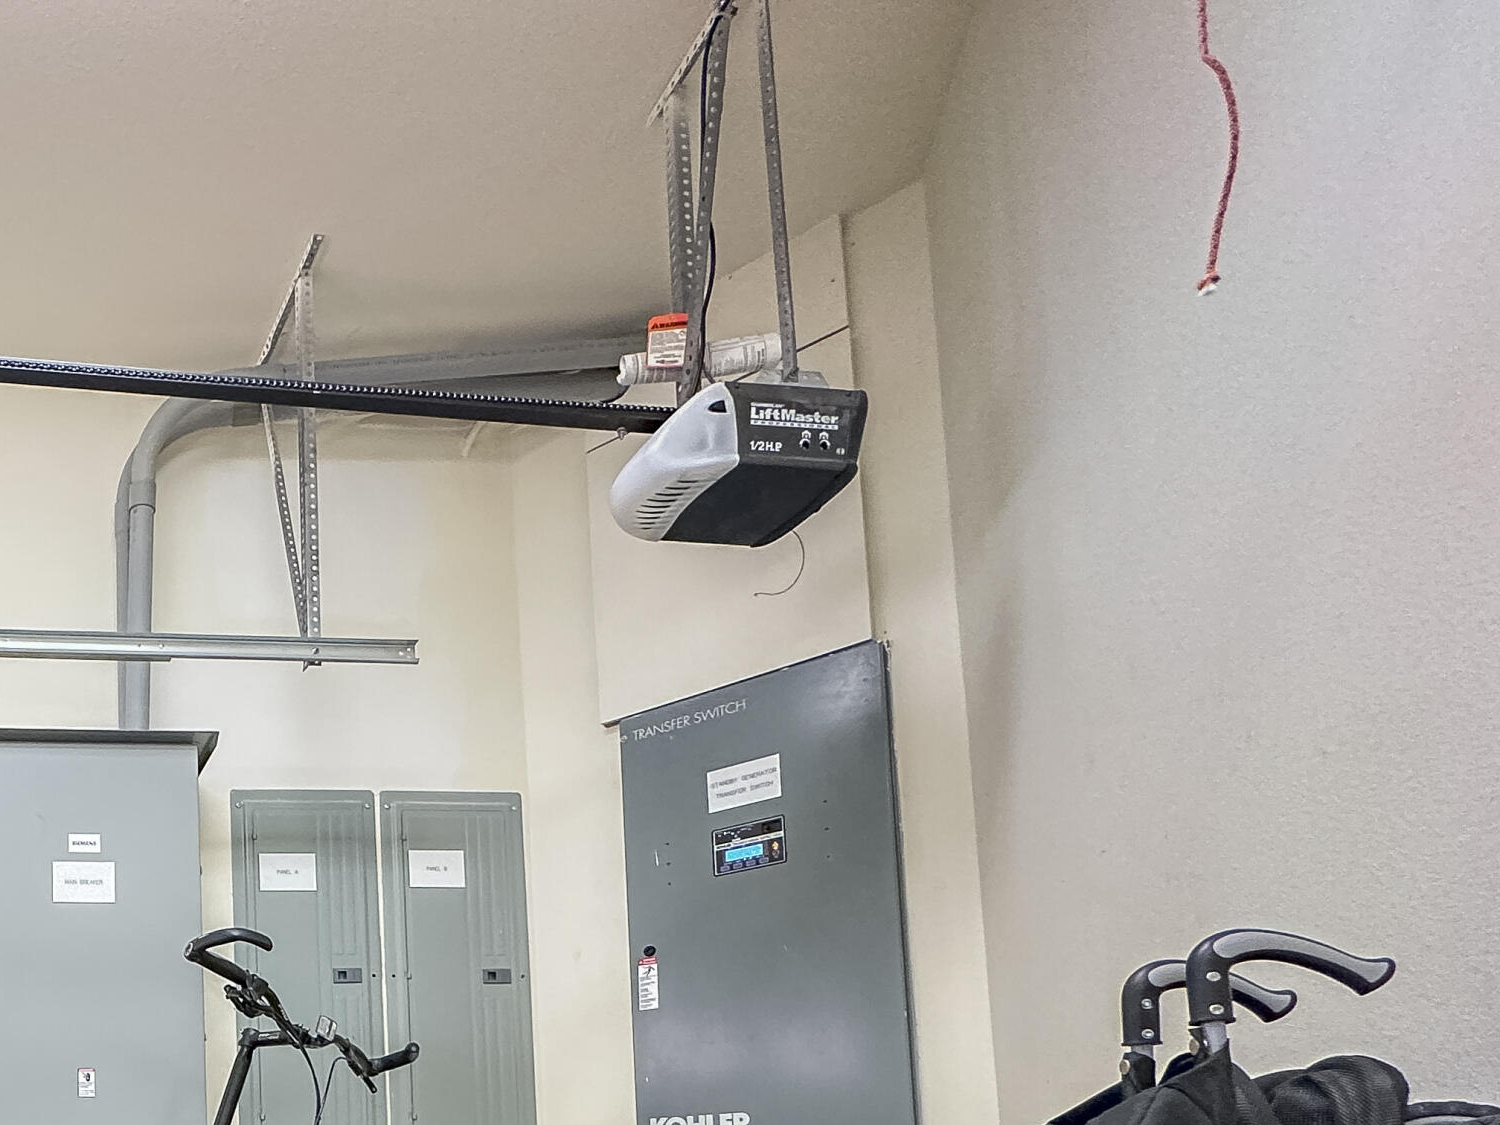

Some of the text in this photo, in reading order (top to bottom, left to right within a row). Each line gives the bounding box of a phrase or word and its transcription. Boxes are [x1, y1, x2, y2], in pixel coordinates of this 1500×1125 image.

[750, 406, 839, 424] LiftMaster
[632, 699, 747, 742] TRANSFER SWITCH
[710, 767, 777, 789] STANDBY GENERATOR
[715, 780, 774, 798] TRANSFER SWITCH
